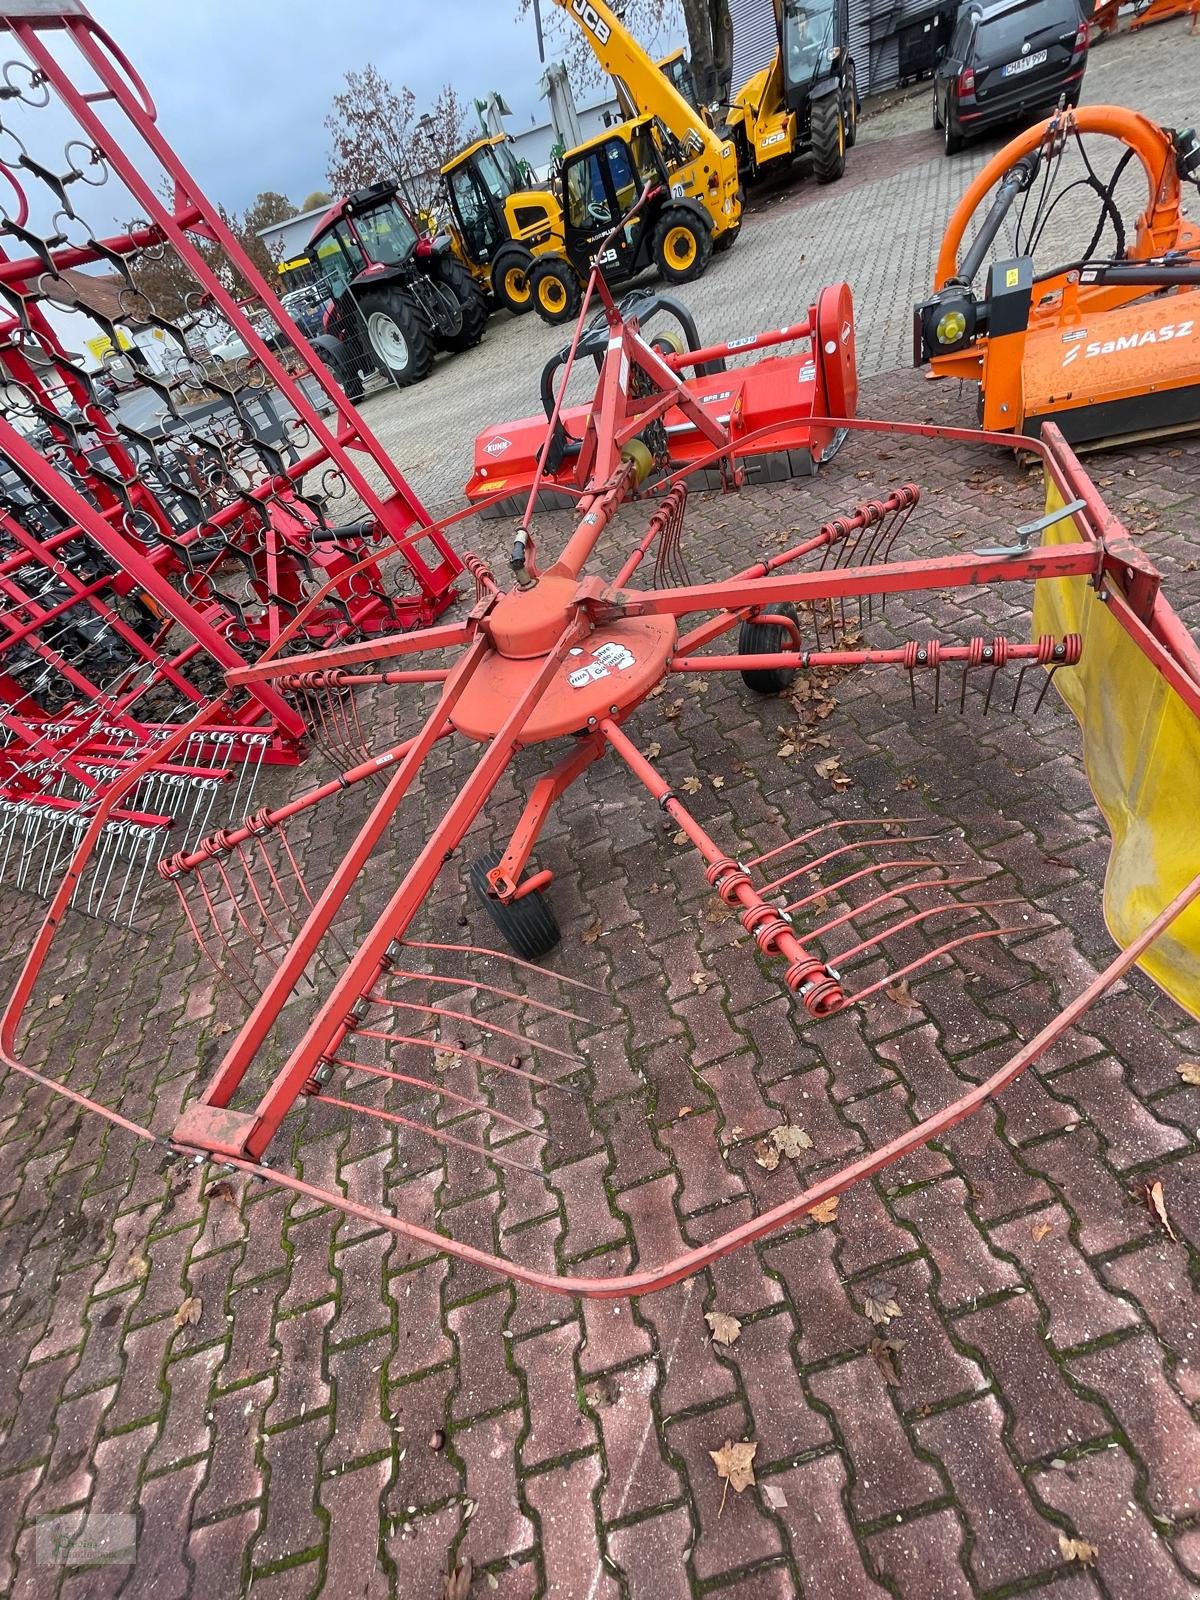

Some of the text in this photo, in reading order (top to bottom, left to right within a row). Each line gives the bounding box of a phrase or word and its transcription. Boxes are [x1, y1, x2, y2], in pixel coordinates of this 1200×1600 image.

[572, 0, 610, 44] JCB
[1007, 51, 1046, 73] CHA V 999
[761, 133, 785, 147] JCB
[1085, 321, 1194, 358] SaMASZ
[488, 441, 508, 452] KUHN
